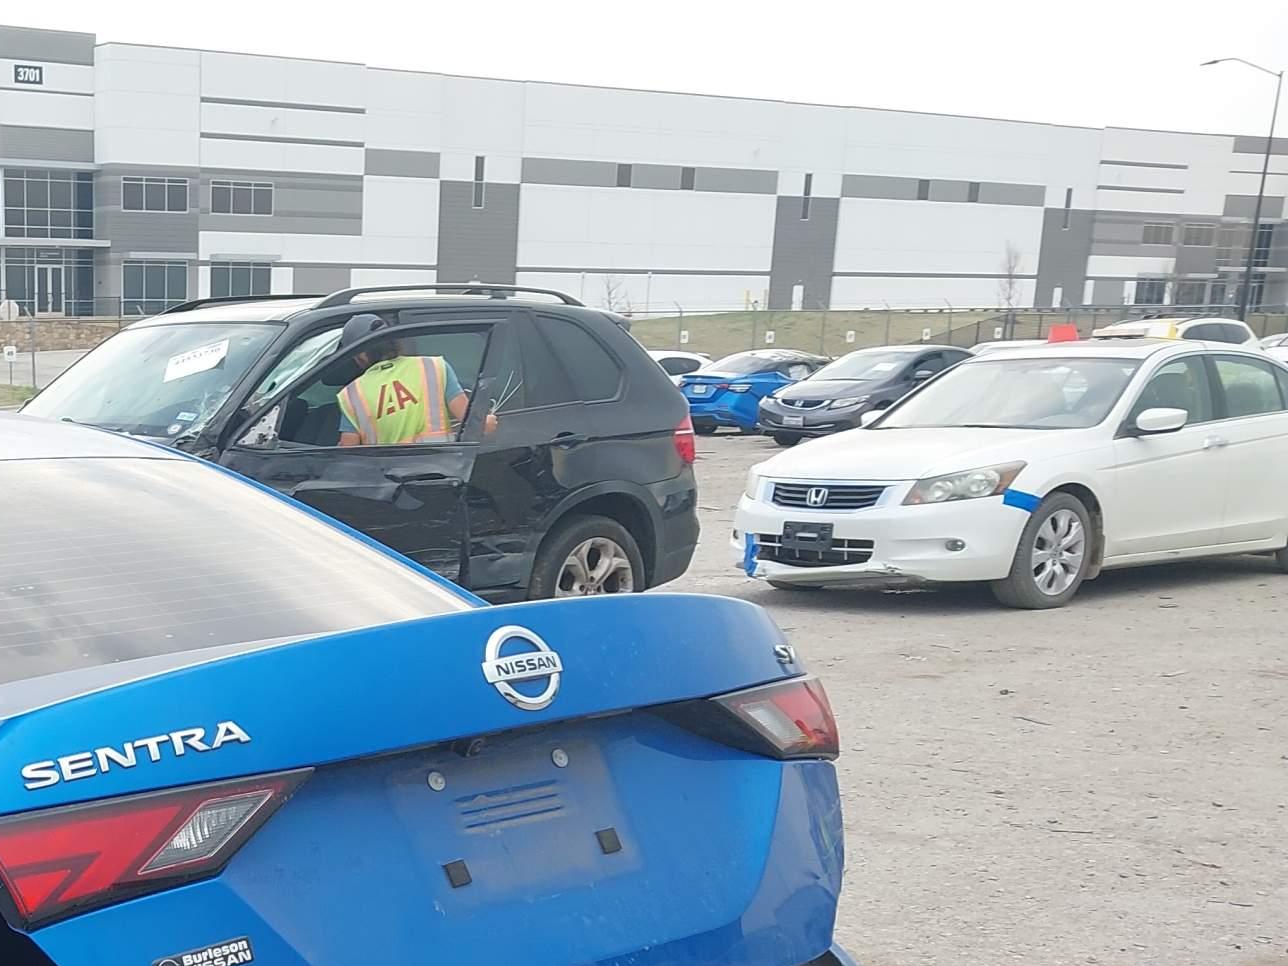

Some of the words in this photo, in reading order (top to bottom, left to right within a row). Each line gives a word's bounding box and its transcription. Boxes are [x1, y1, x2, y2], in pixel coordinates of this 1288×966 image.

[17, 67, 40, 82] 3701
[495, 655, 558, 677] NISSAN
[21, 720, 252, 790] SENTRA
[182, 939, 248, 966] Burleson
